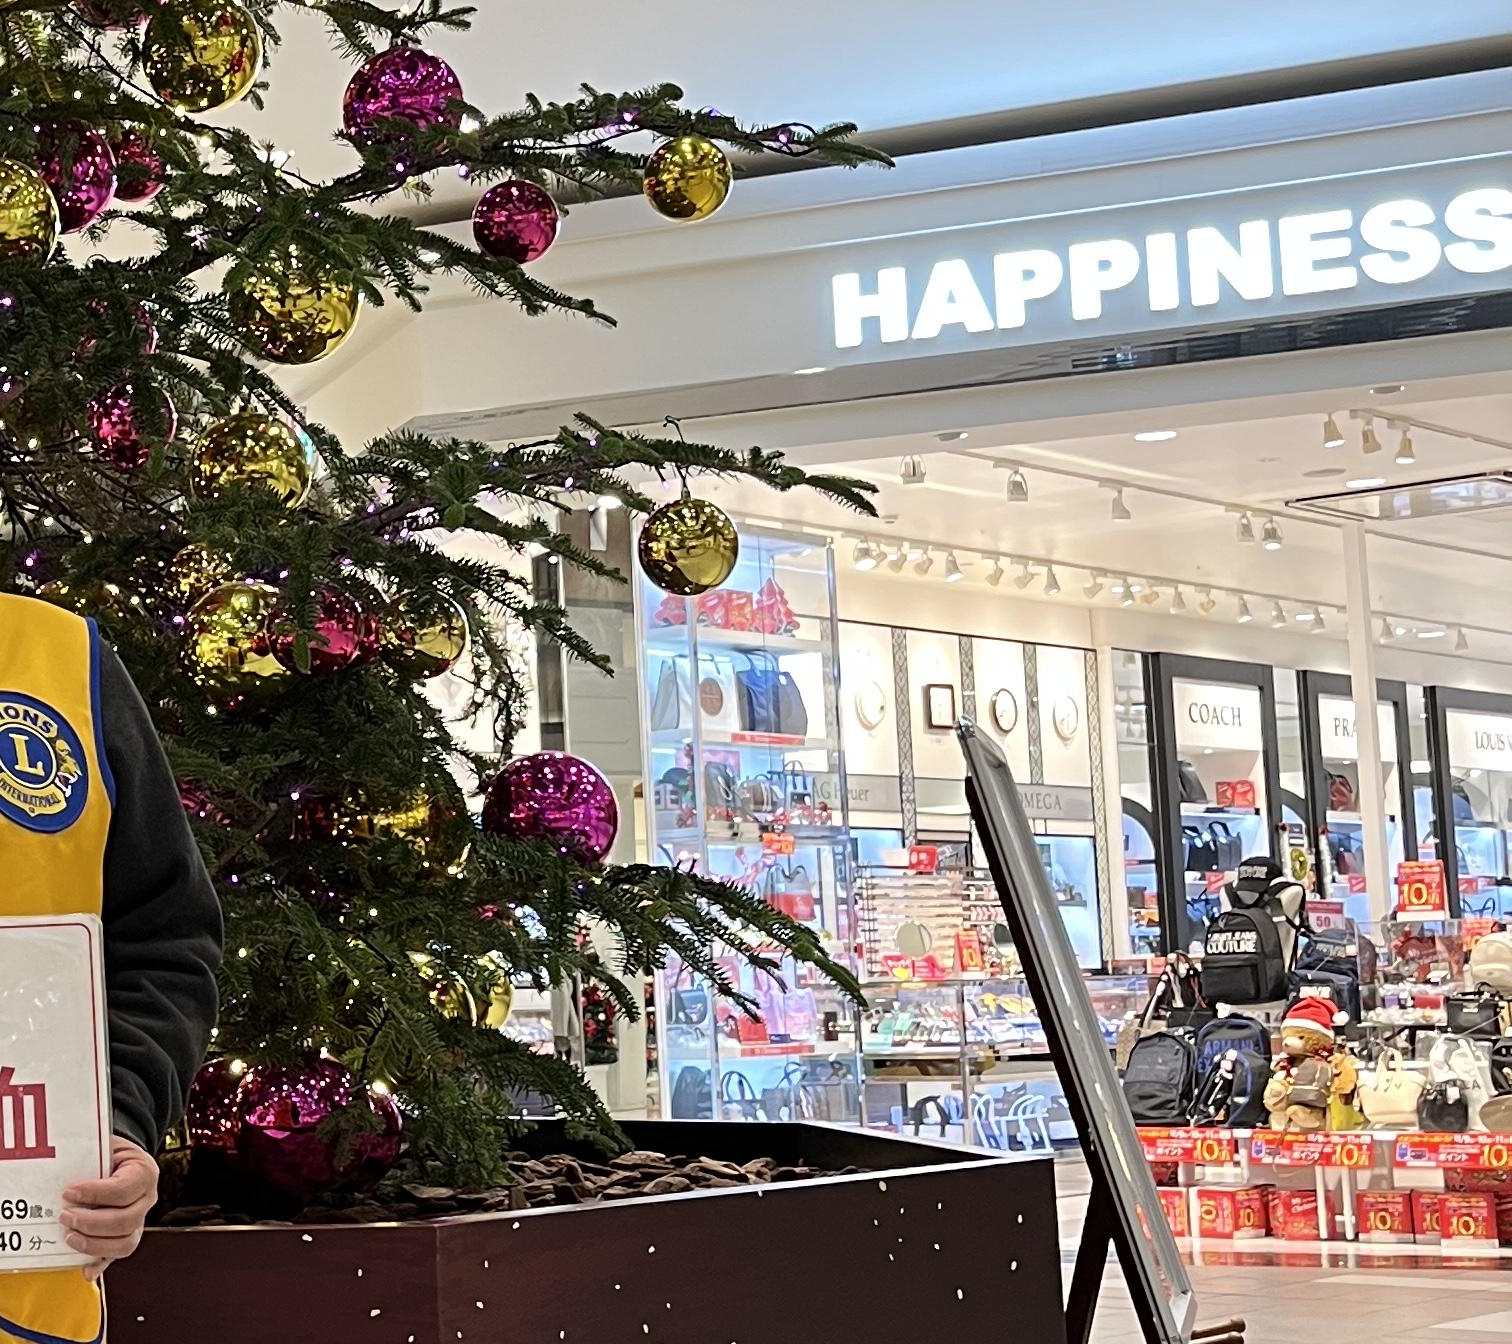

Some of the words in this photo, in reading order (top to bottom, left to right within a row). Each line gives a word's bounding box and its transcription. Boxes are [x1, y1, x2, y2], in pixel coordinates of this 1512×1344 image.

[832, 188, 1512, 348] HAPPINESS
[1188, 702, 1242, 727] COACH
[1474, 731, 1506, 751] LOUIS
[8, 733, 45, 776] L
[1315, 916, 1332, 928] 50
[1207, 940, 1257, 953] COUTURE
